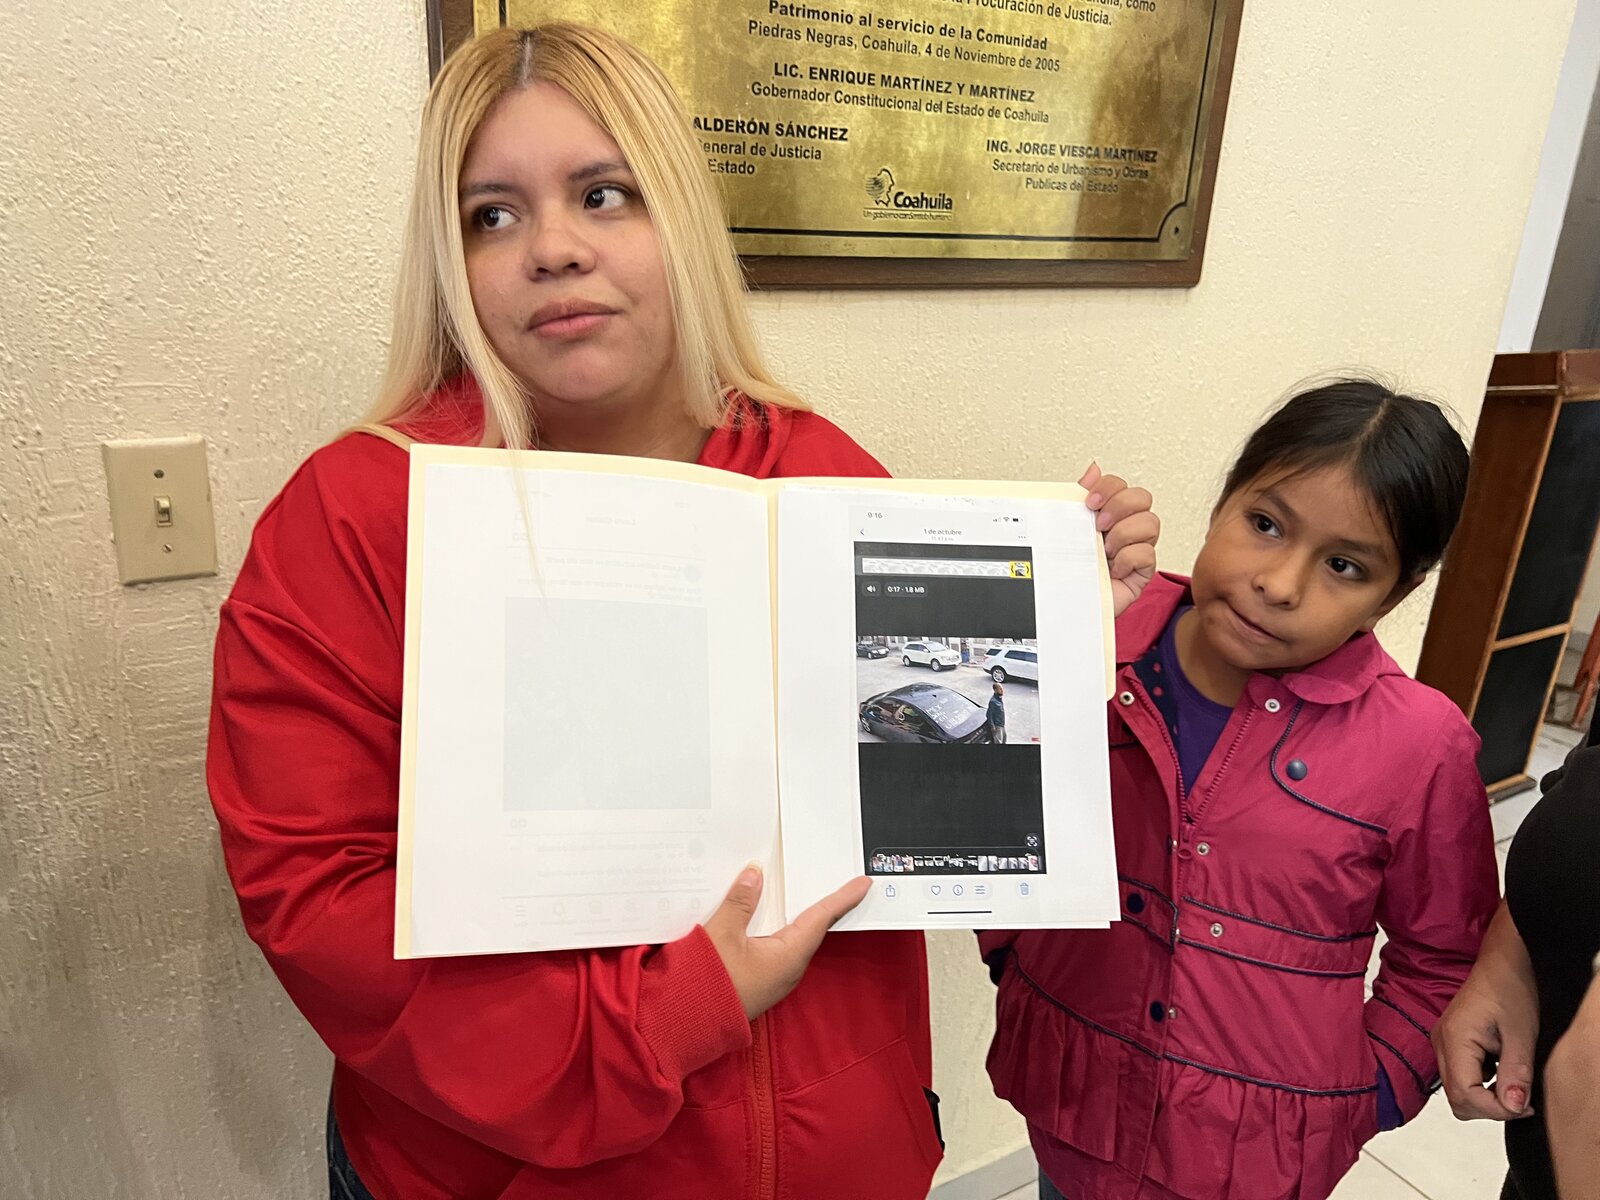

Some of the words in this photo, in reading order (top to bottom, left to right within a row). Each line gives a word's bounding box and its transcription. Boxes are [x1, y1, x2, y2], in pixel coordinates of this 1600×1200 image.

[768, 0, 853, 25] Patrimonio
[859, 13, 872, 27] al
[877, 17, 935, 36] servicio
[940, 23, 956, 38] de
[960, 26, 972, 41] la
[976, 29, 1048, 50] Comunidad
[1047, 3, 1061, 18] de
[1064, 5, 1112, 26] Justicia.
[749, 20, 801, 41] Piedras
[806, 28, 857, 49] Negras,
[862, 35, 921, 56] Coahuila,
[925, 43, 932, 55] 4
[936, 45, 951, 59] de
[954, 46, 1016, 67] Noviembre
[1019, 55, 1032, 69] de
[1035, 57, 1060, 72] 2005
[774, 62, 803, 79] LIC.
[809, 66, 876, 87] ENRIQUE
[880, 73, 952, 94] MARTÍNEZ
[957, 83, 965, 95] Y
[969, 84, 1035, 103] MARTÍNEZ
[751, 81, 831, 103] Gobernador
[834, 90, 922, 112] Constitucional
[925, 98, 942, 113] del
[946, 102, 984, 118] Estado
[988, 104, 1000, 119] de
[1004, 107, 1049, 124] Coahuila
[693, 116, 770, 136] ALDERÓN
[775, 121, 848, 142] SÁNCHEZ
[698, 138, 746, 156] eneral
[750, 142, 766, 157] de
[770, 143, 822, 160] Justicia
[986, 139, 1012, 153] ING.
[1015, 141, 1057, 156] JORGE
[1059, 144, 1100, 159] VIESCA
[708, 158, 755, 175] Estado
[992, 158, 1044, 173] Secretario
[1047, 162, 1059, 174] de
[1062, 163, 1113, 177] Urbanismo
[1113, 168, 1121, 180] y
[1122, 166, 1149, 180] Obras
[1070, 179, 1084, 192] del
[1087, 182, 1119, 193] Estado
[893, 191, 953, 210] Coahuila
